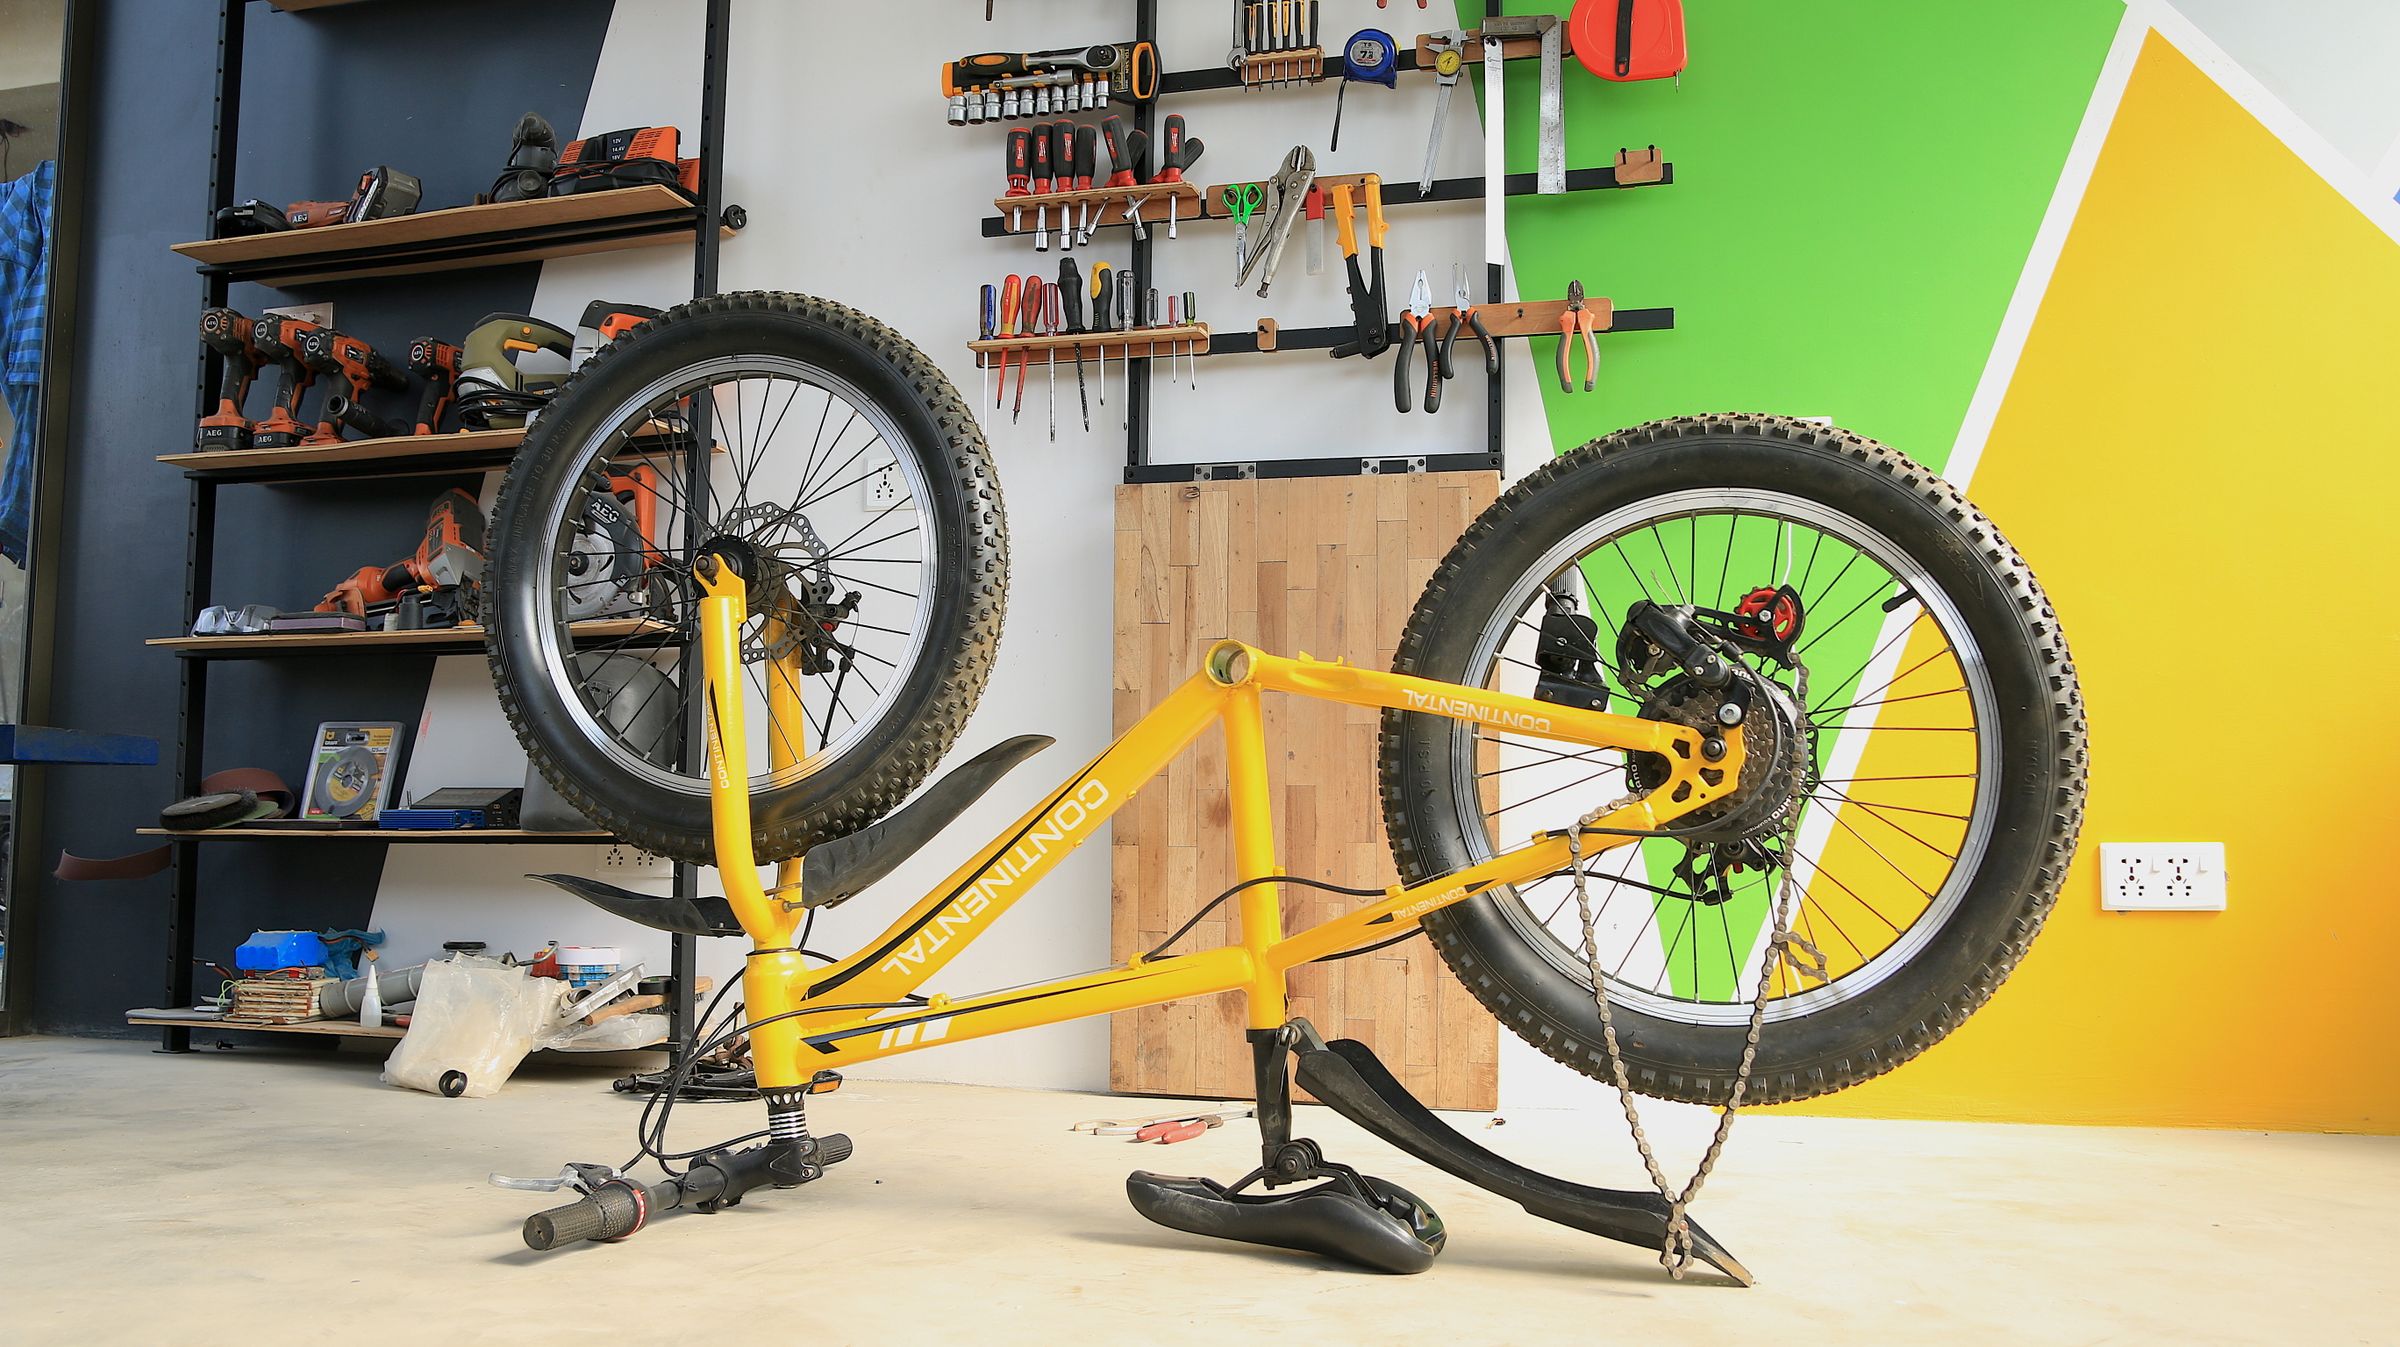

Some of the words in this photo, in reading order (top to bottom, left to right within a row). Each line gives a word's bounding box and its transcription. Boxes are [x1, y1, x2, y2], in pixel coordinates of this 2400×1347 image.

[292, 213, 308, 223] AEG
[206, 429, 222, 437] AEG
[591, 498, 620, 523] AEG
[1402, 688, 1551, 733] CONTINENTAL
[1424, 805, 1439, 825] TO
[880, 778, 1110, 976] CONTINENTAL
[1393, 886, 1468, 919] CONTINENTAL
